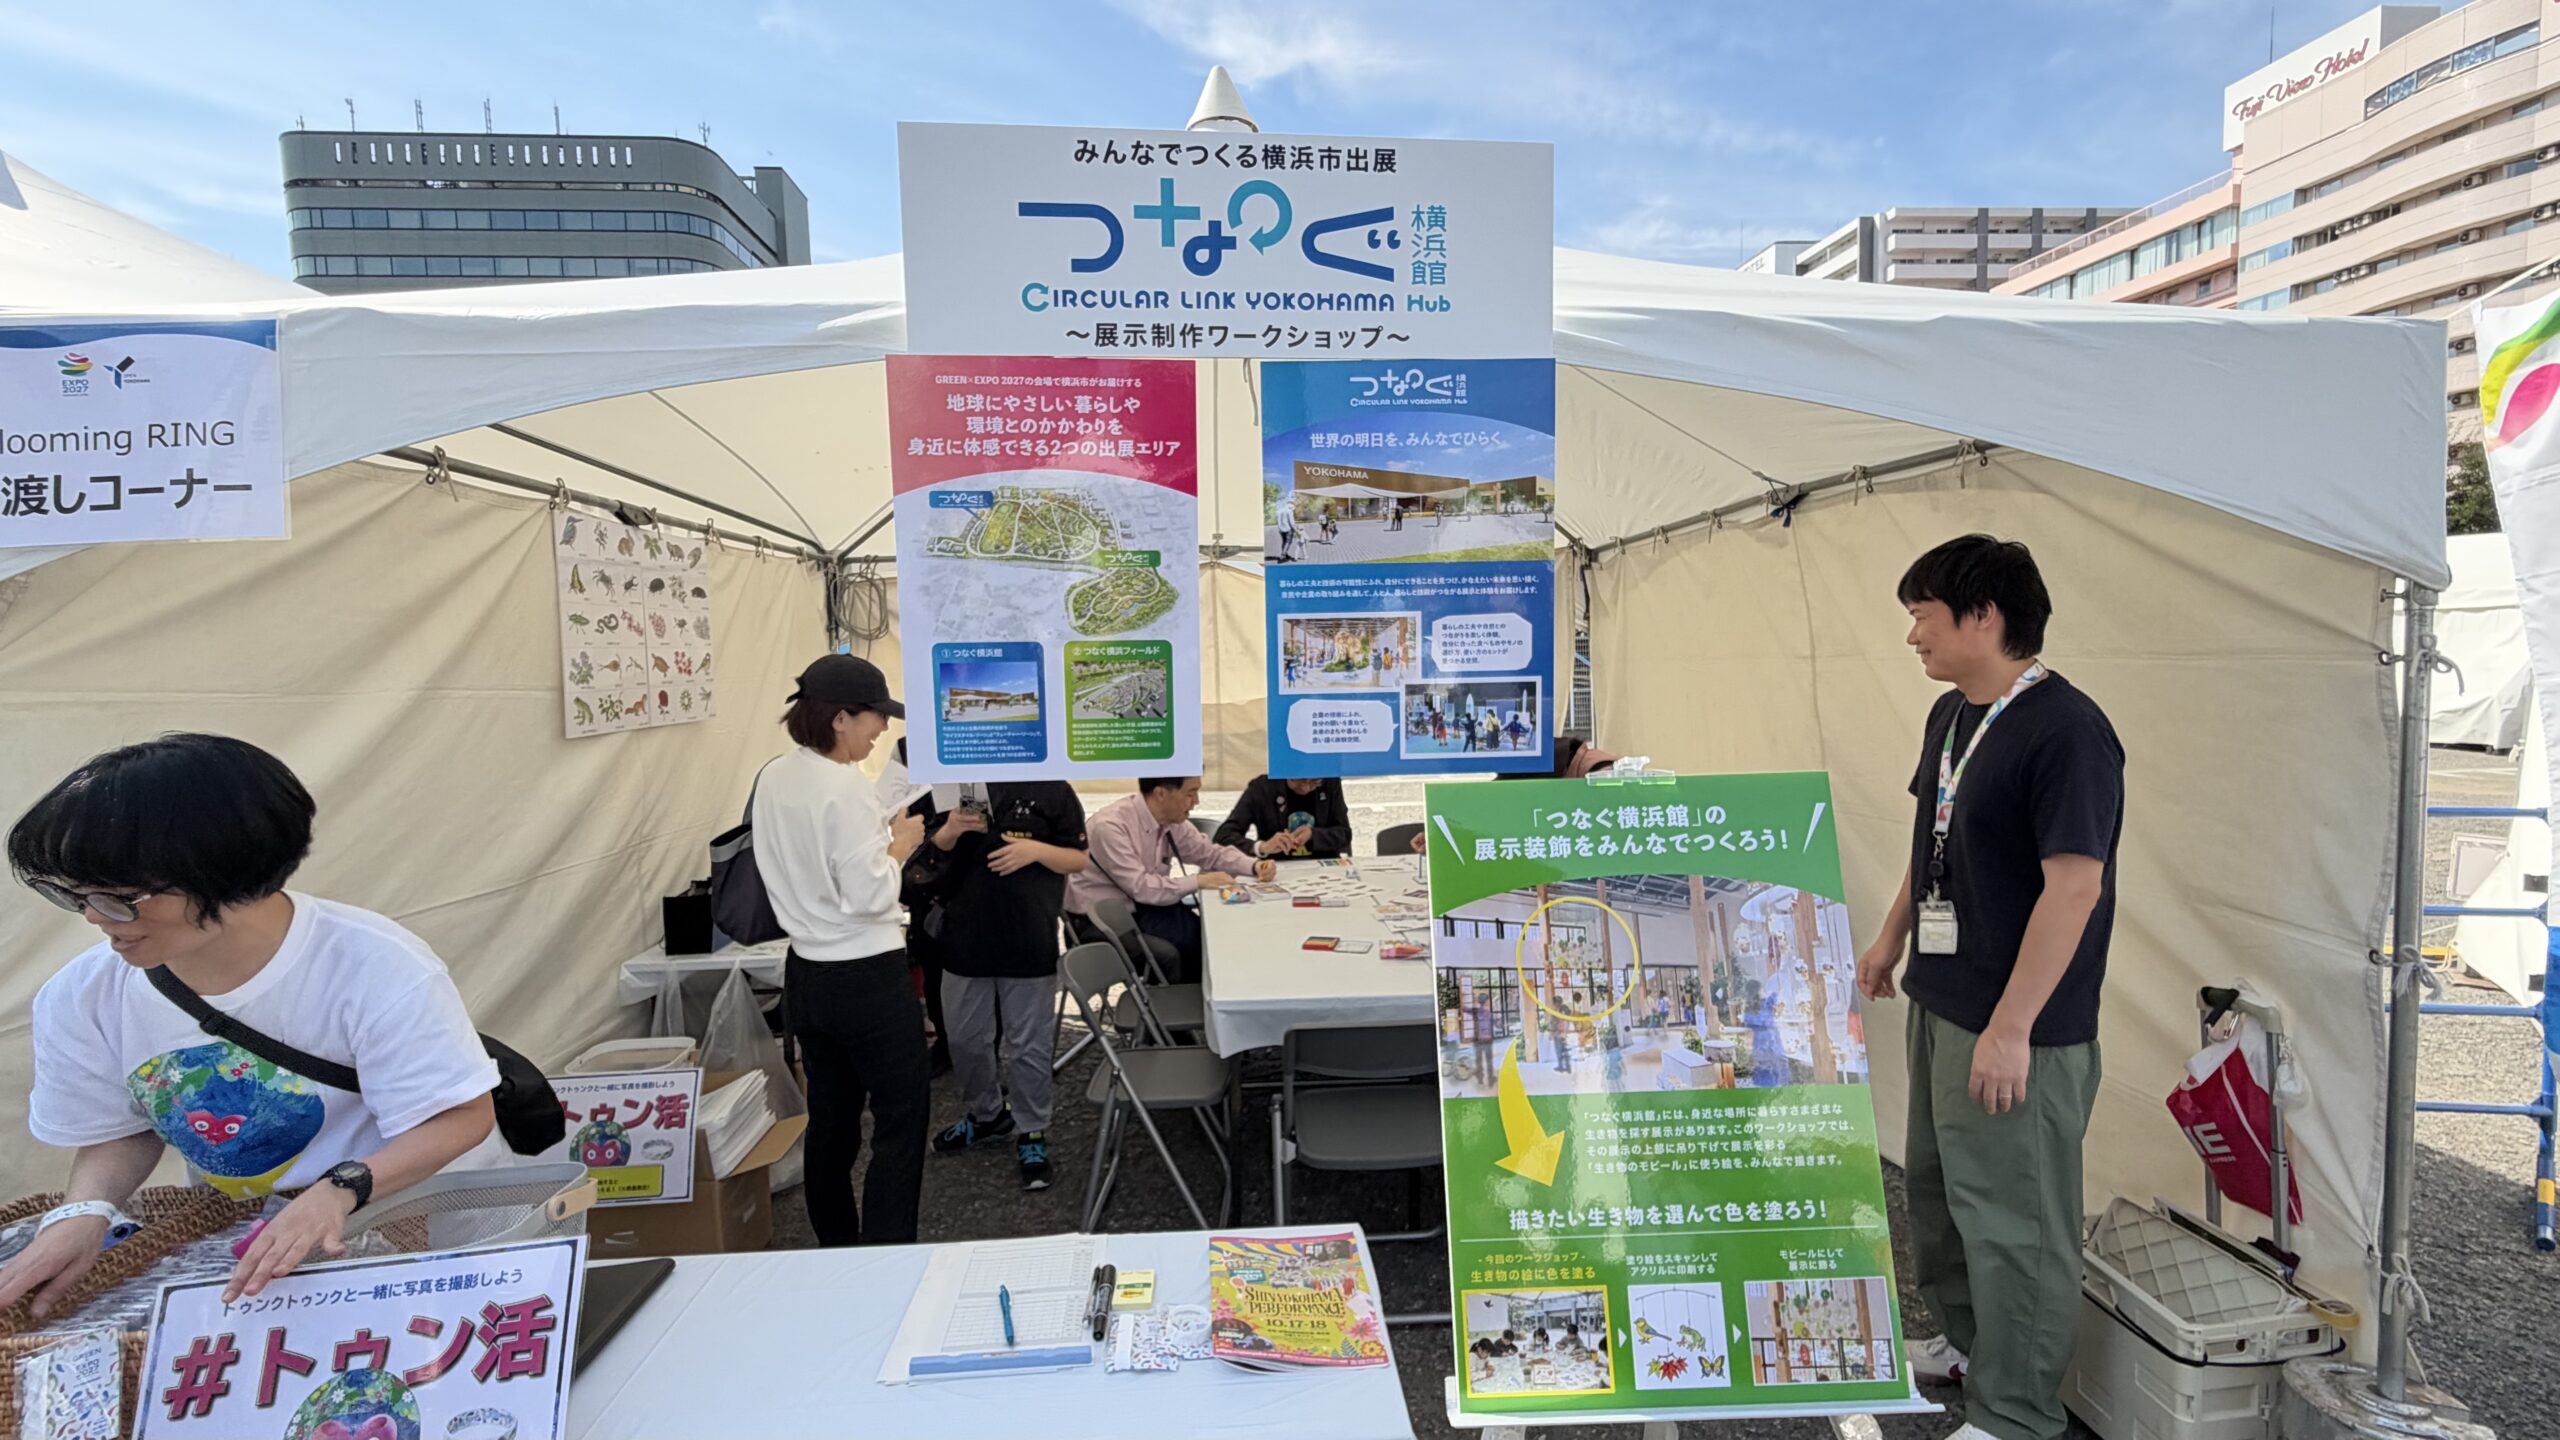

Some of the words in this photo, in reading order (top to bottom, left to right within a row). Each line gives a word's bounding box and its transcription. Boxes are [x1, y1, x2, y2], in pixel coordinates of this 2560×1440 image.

[1074, 139, 1397, 174] みんなでつくる横浜市出展
[1018, 177, 1401, 283] つなぐ
[1411, 203, 1448, 287] 横浜館
[1021, 282, 1169, 313] CIRCULAR
[1245, 292, 1395, 312] YOKOHAMA
[1406, 294, 1451, 313] Hub
[946, 394, 1141, 413] 地球にやさしい暮らしや
[147, 421, 236, 449] RING
[966, 417, 1123, 435] 環境とのかかわりを
[907, 437, 1181, 457] 身近に体感できる2つの出展エリア
[1303, 466, 1369, 479] YOKOHAMA
[1, 468, 253, 517] 渡しコーナー
[1532, 805, 1727, 830] 「つなぐ横浜館」の
[1474, 829, 1789, 861] 展示装飾をみんなでつくろう！
[1508, 1199, 1828, 1231] 描きたい生き物を選んで色を塗ろう！
[1625, 1252, 1718, 1266] 塗り絵をスキャンして
[1779, 1248, 1844, 1260] モビールにして
[1788, 1259, 1838, 1272] 展示に飾る
[1471, 1266, 1596, 1283] 生き物の絵に色を塗る
[1630, 1264, 1716, 1277] アクリルに印刷する
[223, 1268, 524, 1317] トゥンクトゥンクと一緒に写真を撮影しよう
